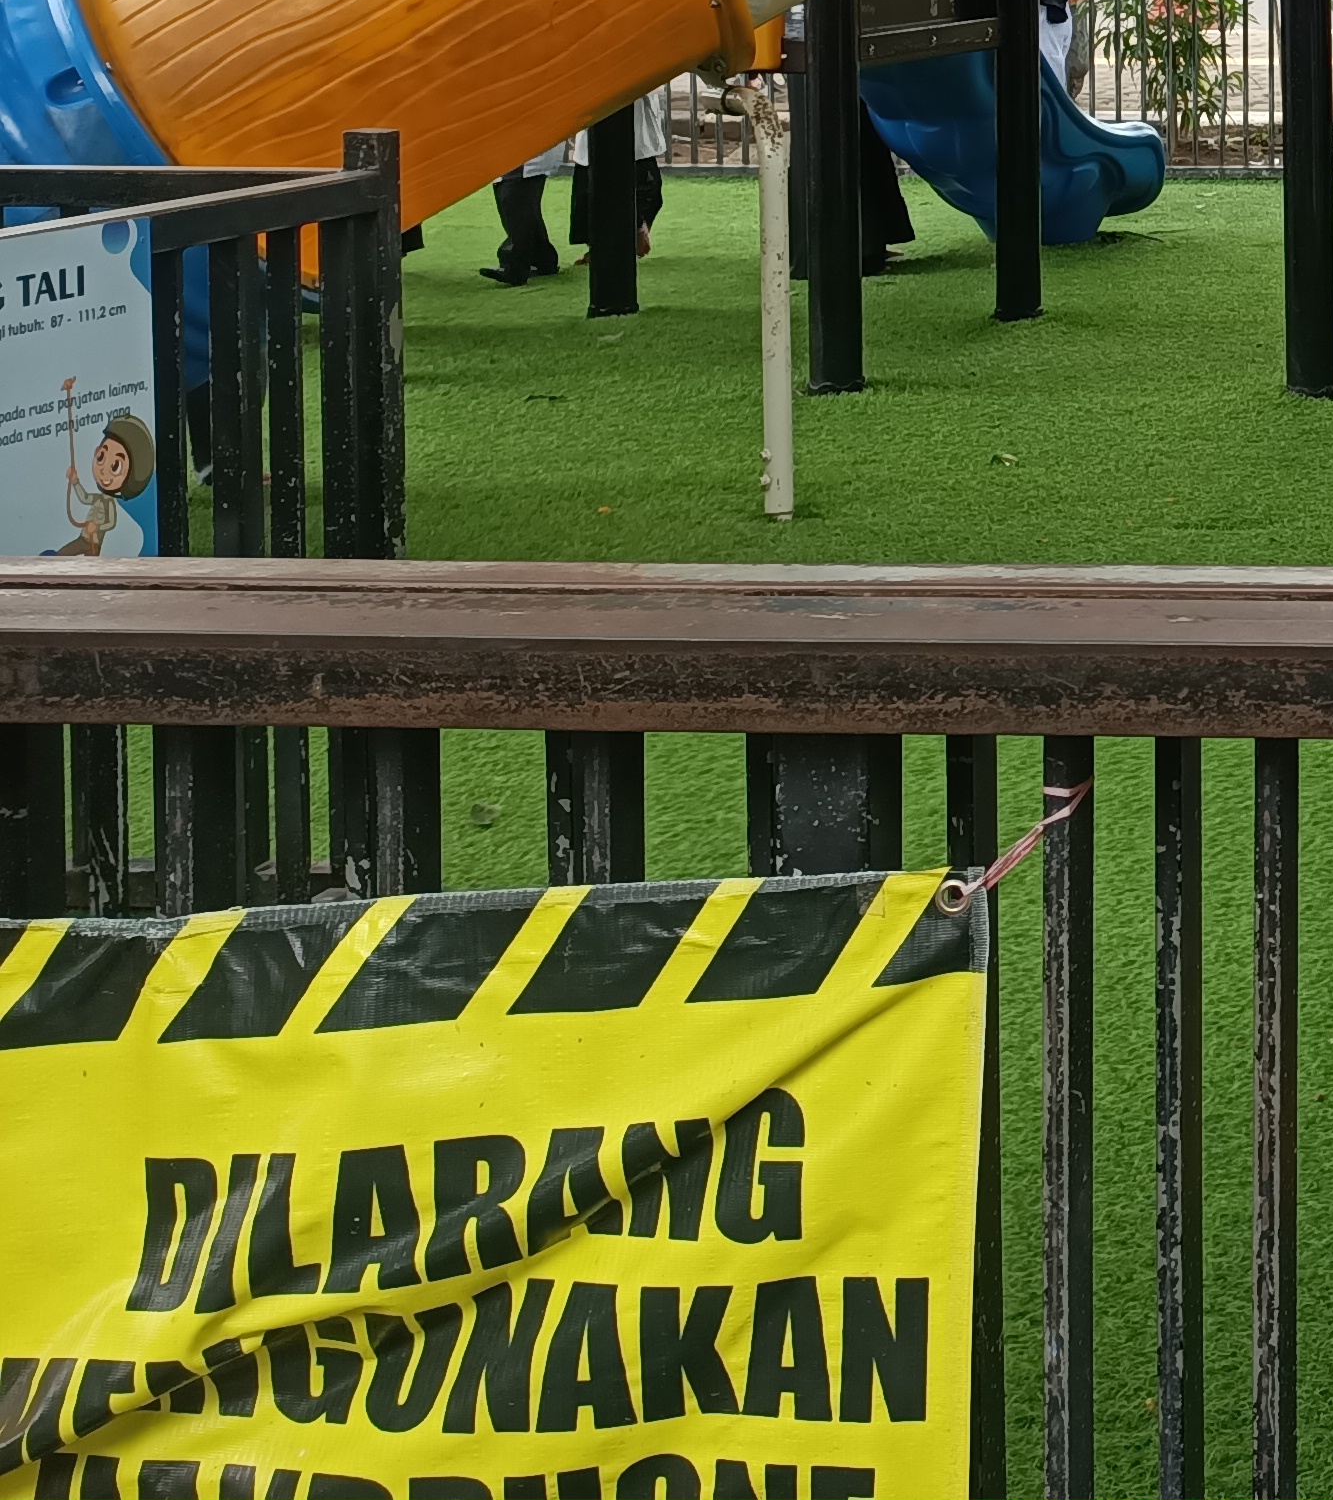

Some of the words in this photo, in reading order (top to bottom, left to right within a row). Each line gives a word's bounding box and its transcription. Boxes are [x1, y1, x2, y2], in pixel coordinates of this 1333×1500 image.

[16, 265, 85, 307] TALI
[8, 319, 45, 337] tubuh:
[50, 314, 64, 328] 87
[78, 305, 106, 323] 111,2
[108, 304, 127, 317] cm
[28, 400, 54, 417] ruas
[57, 389, 105, 414] panjatan
[108, 380, 149, 399] lainnya,
[26, 423, 52, 440] ruas
[55, 411, 104, 437] panjatan
[125, 1087, 806, 1314] DILARANG
